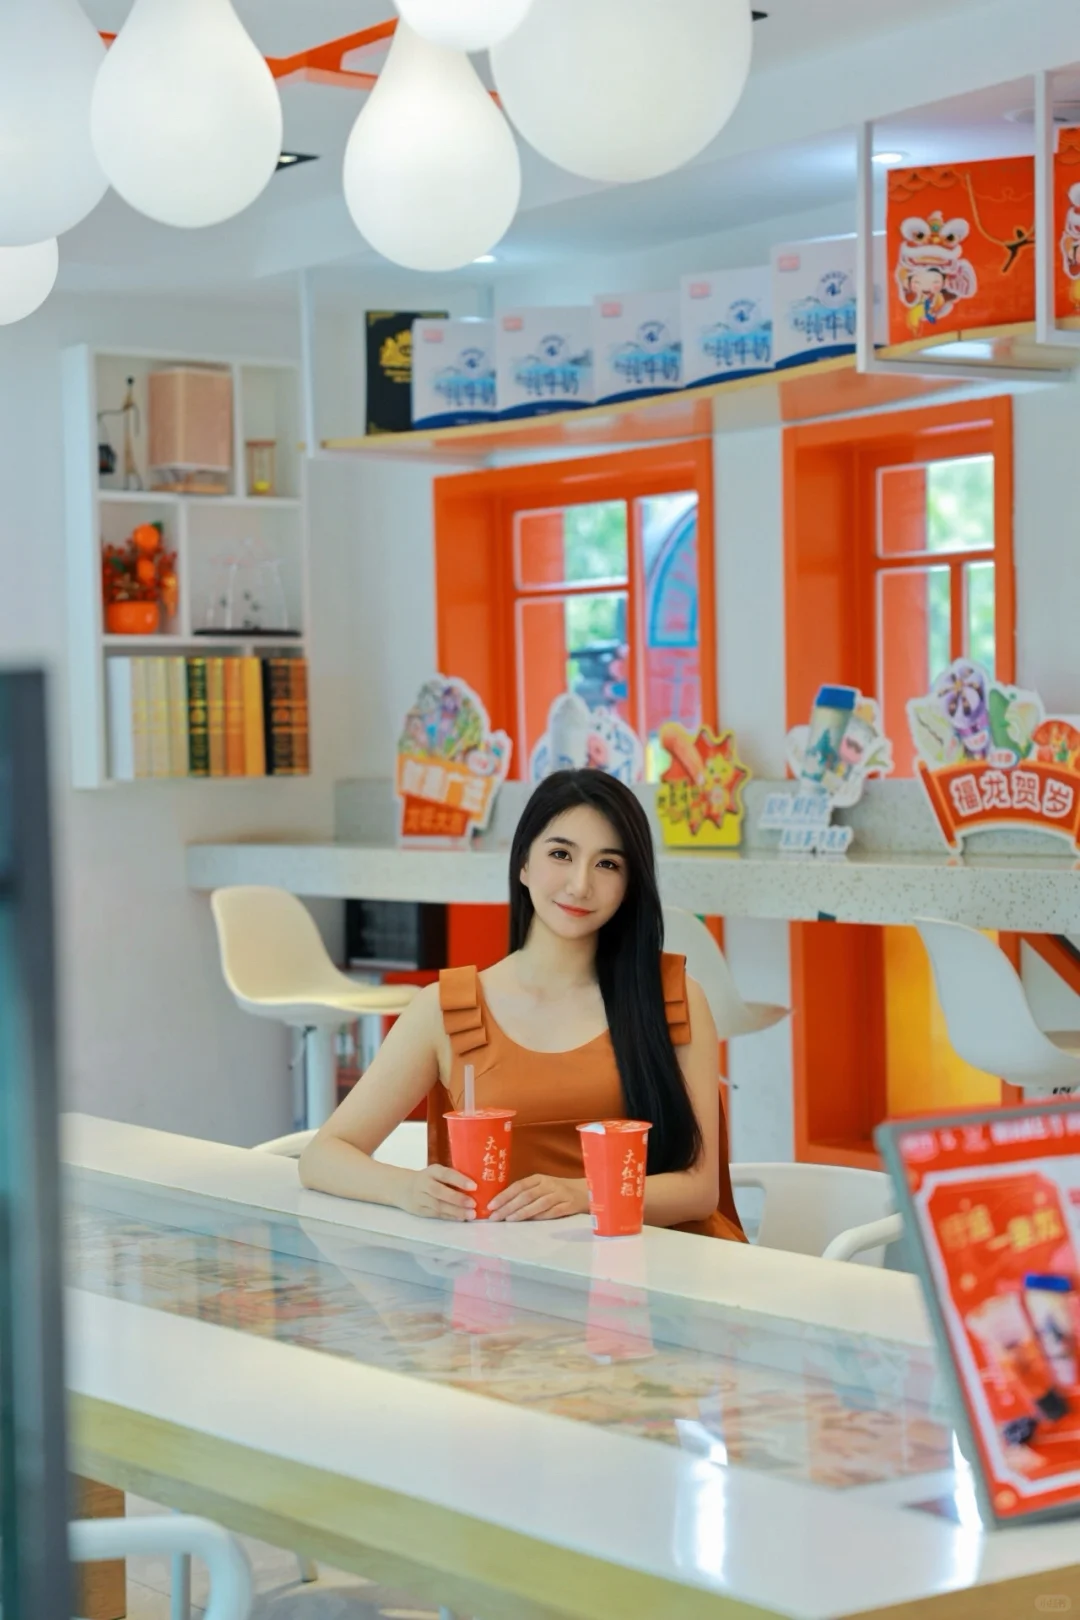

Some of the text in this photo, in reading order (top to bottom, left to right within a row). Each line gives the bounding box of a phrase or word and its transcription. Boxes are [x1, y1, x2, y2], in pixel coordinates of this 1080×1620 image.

[951, 771, 1073, 817] 福龙贺岁
[482, 1136, 497, 1181] 大红袍
[621, 1149, 636, 1196] 大红袍
